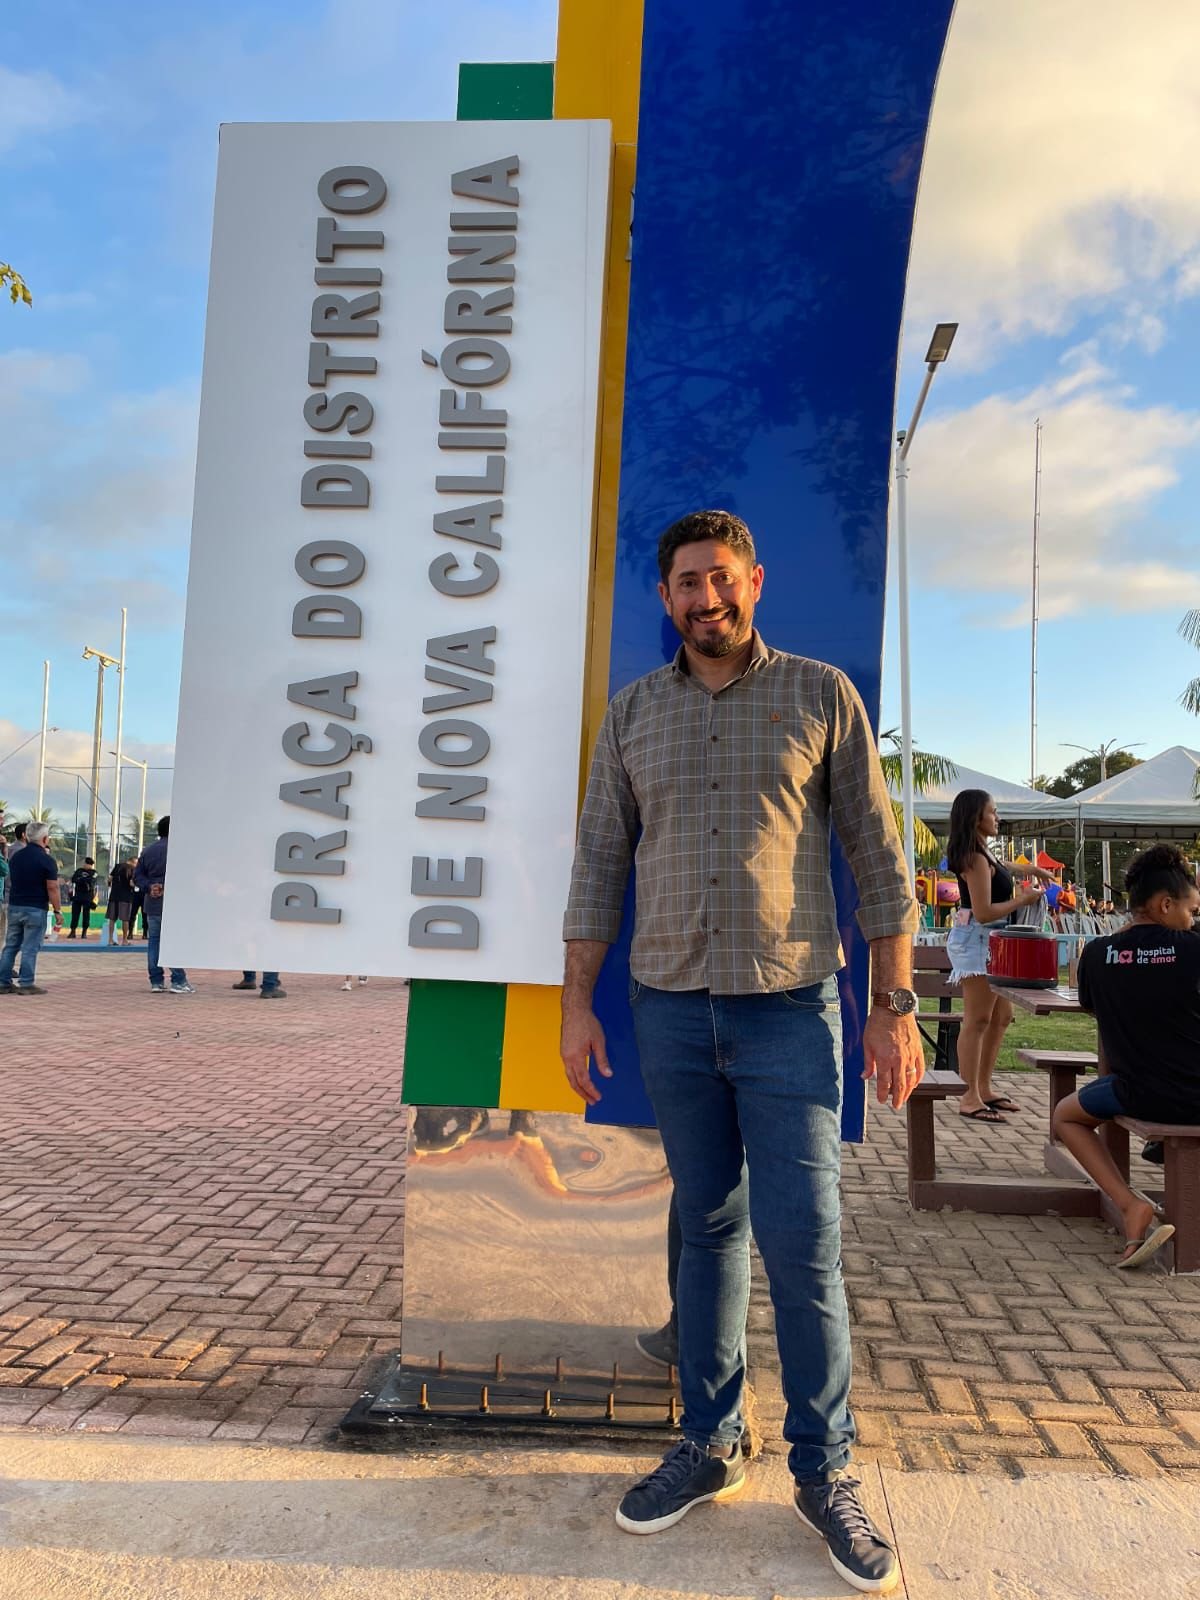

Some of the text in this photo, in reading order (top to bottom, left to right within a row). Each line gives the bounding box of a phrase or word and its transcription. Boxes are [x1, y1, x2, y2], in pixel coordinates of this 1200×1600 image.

[270, 165, 388, 924] PRAÇA DO DISTRITO
[408, 155, 520, 950] DE NOVA CALIFÓRNIA
[1137, 946, 1175, 957] hospital
[1137, 955, 1177, 964] de amor
